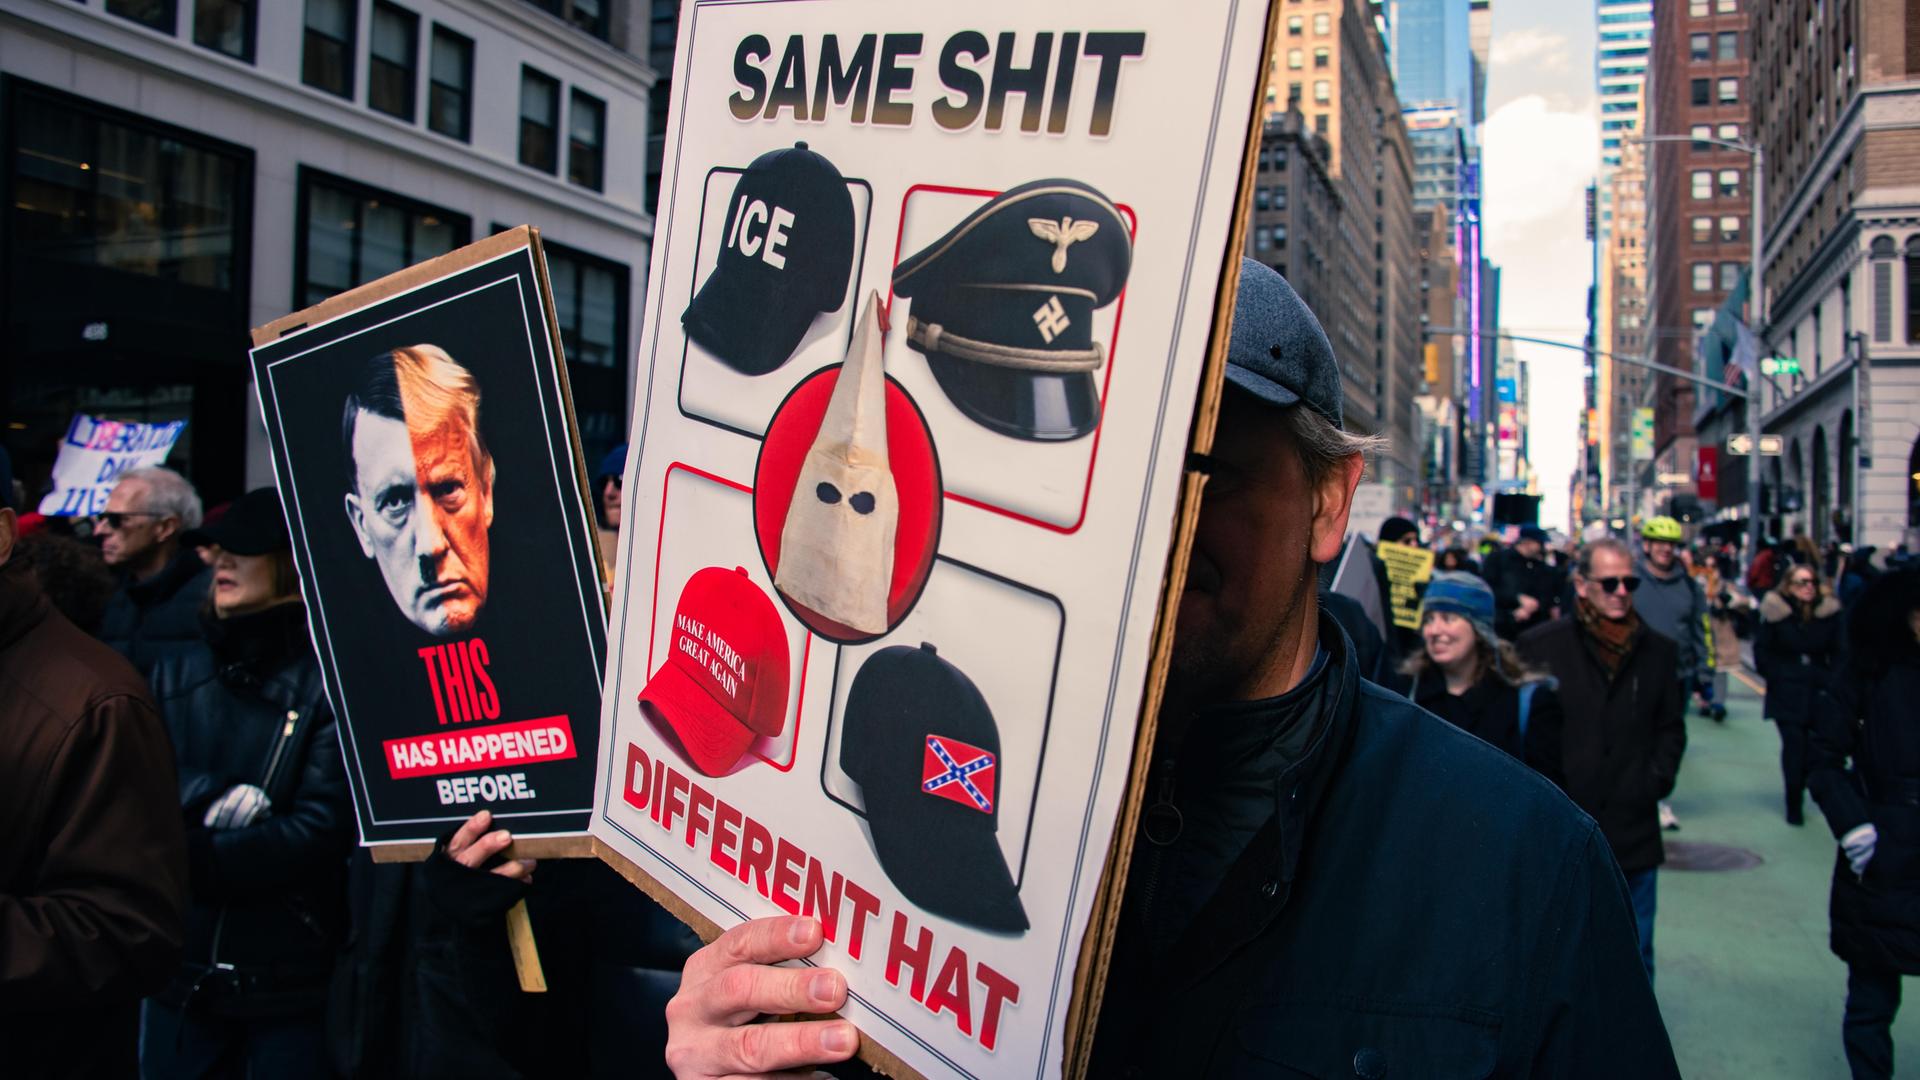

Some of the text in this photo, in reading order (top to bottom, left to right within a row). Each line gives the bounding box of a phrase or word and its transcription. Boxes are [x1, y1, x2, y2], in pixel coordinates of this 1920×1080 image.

[728, 30, 1146, 136] SAME SHIT
[728, 195, 795, 270] ICE
[417, 637, 500, 725] THIS
[676, 614, 746, 682] MAKE AMERICA
[679, 635, 738, 699] GREAT AGAIN
[391, 727, 568, 769] HAS HAPPENED
[436, 773, 536, 805] BEFORE.
[623, 742, 1020, 1052] DIFFERENT HAT
